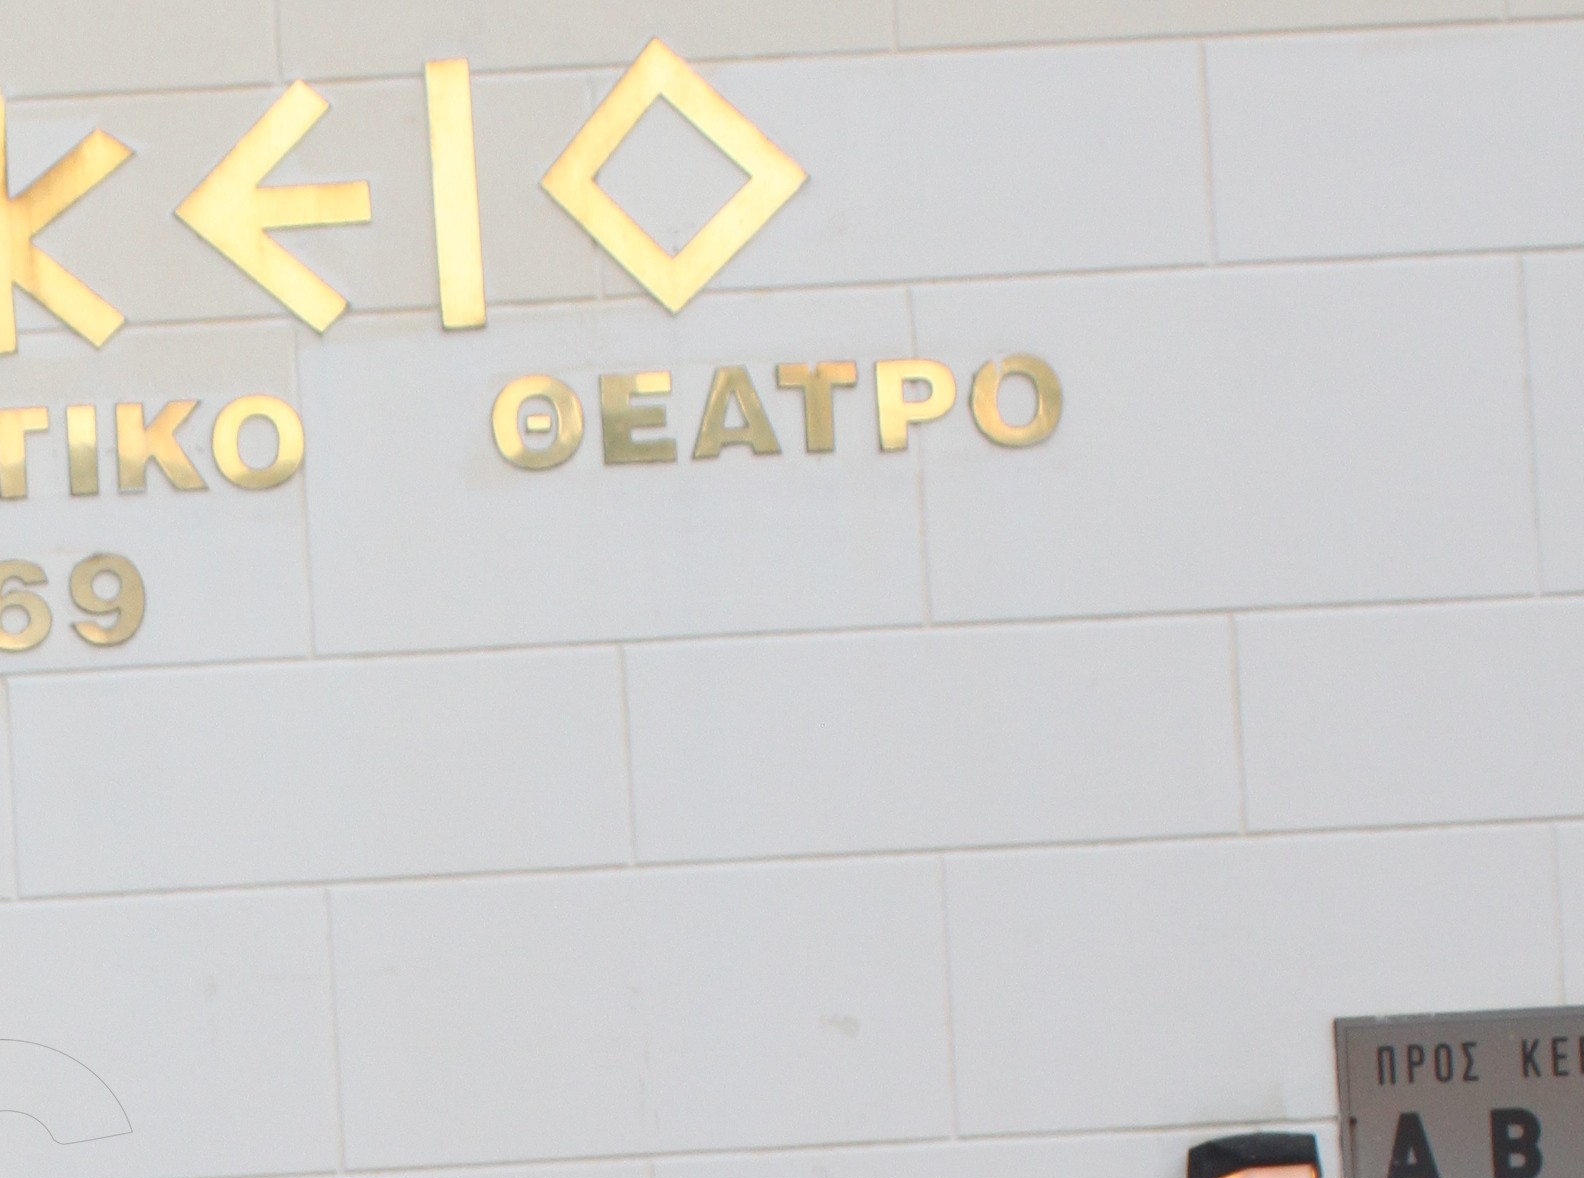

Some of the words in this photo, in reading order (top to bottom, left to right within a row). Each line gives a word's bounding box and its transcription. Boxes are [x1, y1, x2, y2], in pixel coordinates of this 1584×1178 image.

[491, 353, 1063, 471] ΘΕΑΤΡΟ
[1376, 1041, 1480, 1086] ΠΡΟΣ
[1520, 1035, 1584, 1078] ΚΕ
